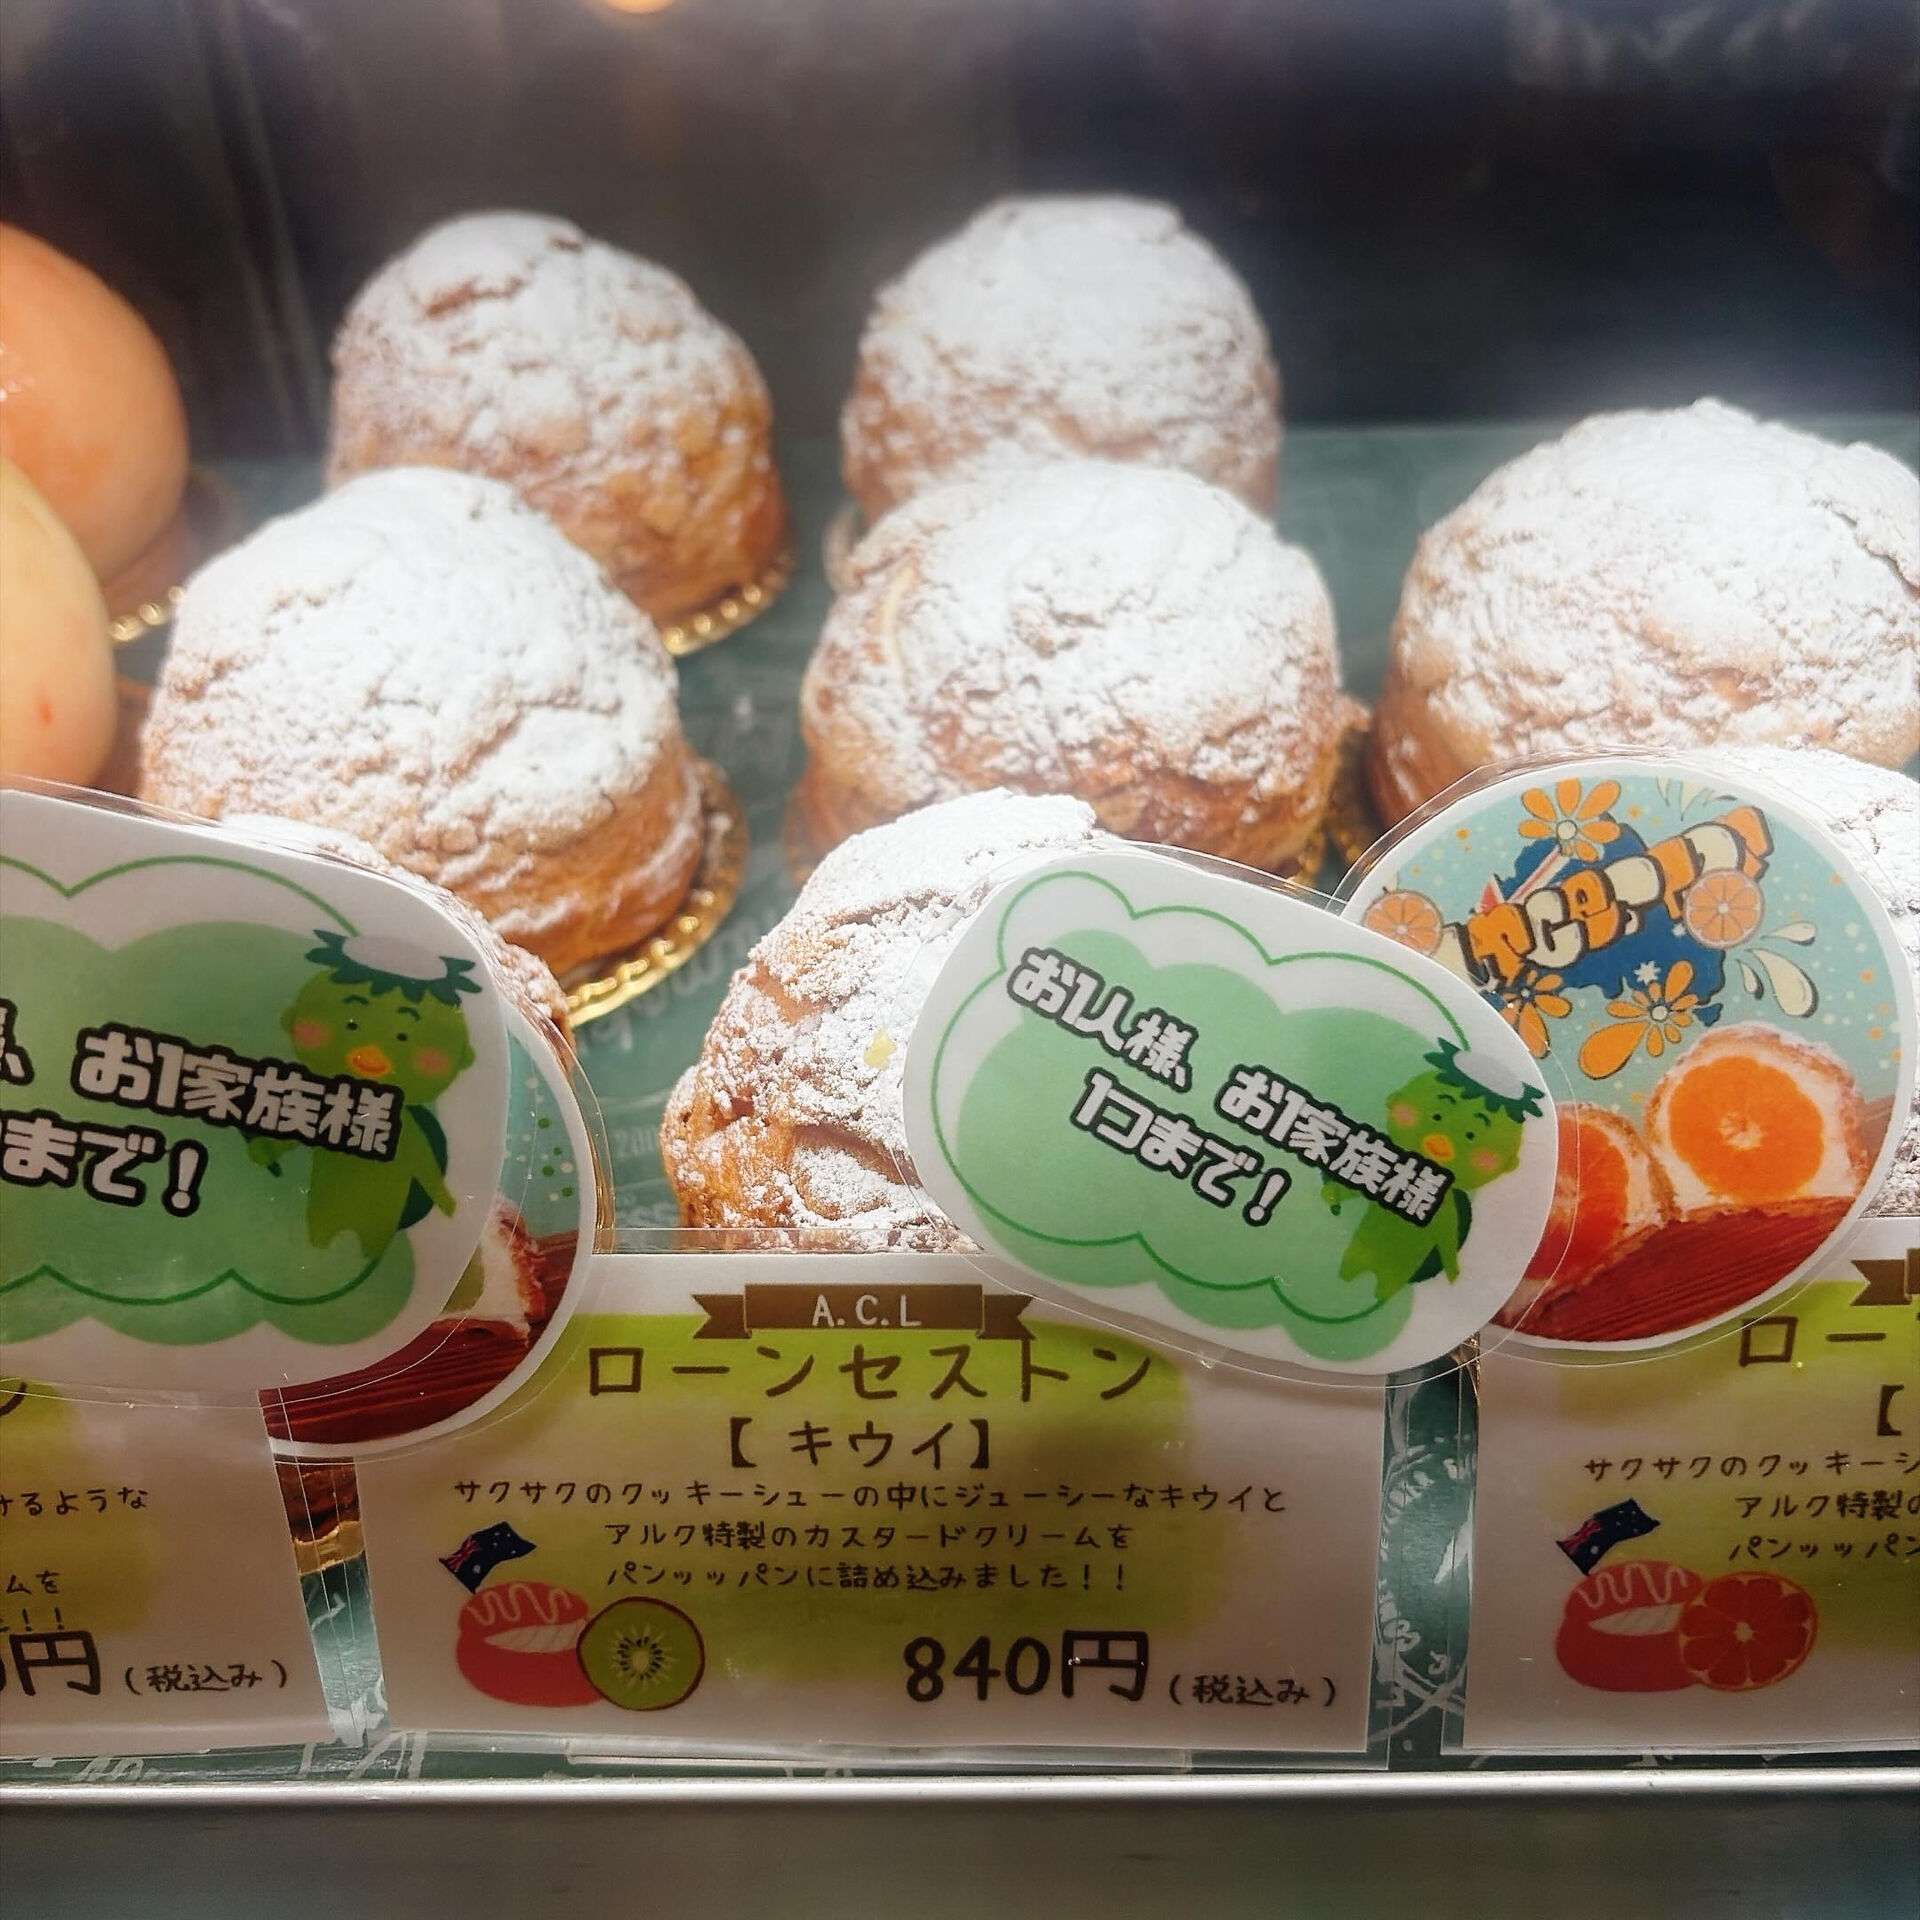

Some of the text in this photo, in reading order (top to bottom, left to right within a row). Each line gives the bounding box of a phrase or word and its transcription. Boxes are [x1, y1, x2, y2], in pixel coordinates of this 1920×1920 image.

[73, 1024, 404, 1161] お1家族様
[1213, 1062, 1456, 1227] お1家族様
[812, 1294, 922, 1328] A.C.L
[1739, 1315, 1920, 1368] ロー
[588, 1338, 1151, 1402] ローンセストン
[729, 1416, 990, 1470] 【キウイ】
[605, 1520, 1133, 1551] アルク特製のカスタードクリームを
[0, 1630, 101, 1697] 円
[903, 1630, 1338, 1707] 840円 （税込み）
